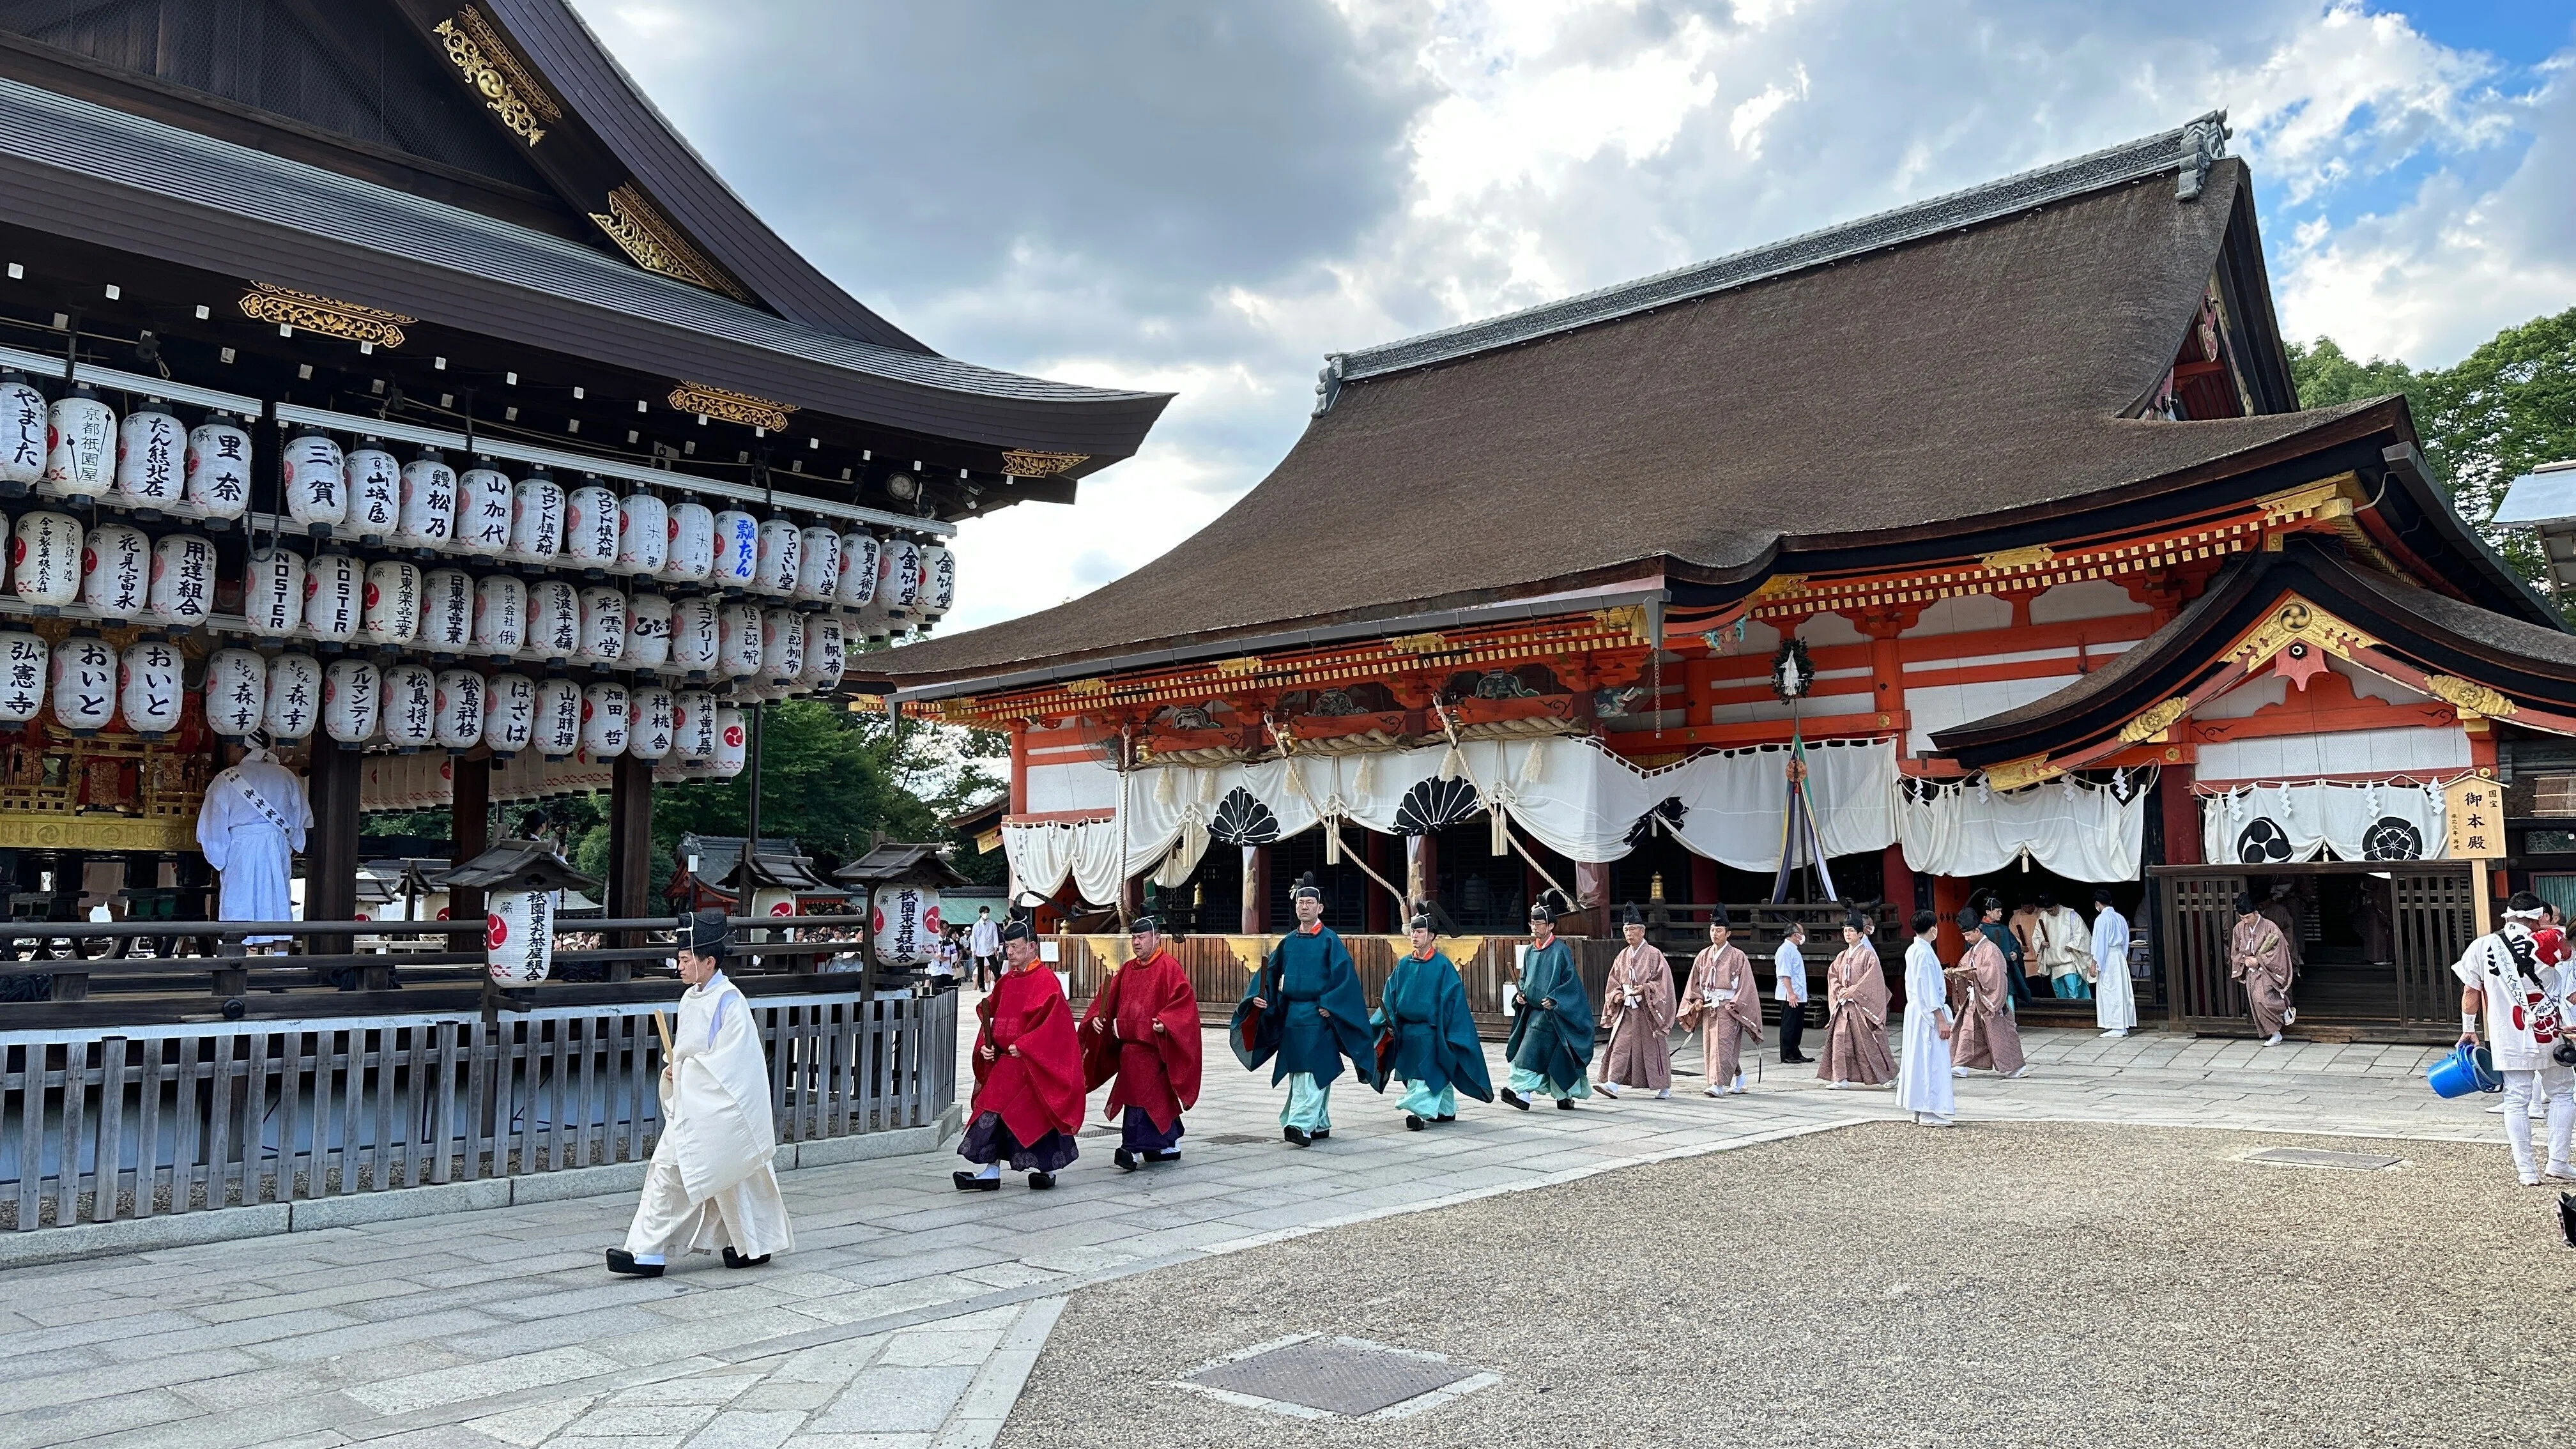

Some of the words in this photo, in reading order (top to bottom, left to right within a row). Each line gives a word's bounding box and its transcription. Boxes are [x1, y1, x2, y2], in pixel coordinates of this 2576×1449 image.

[13, 388, 39, 466] やました
[79, 407, 100, 482] 京都祇園屋
[140, 417, 171, 497] たん熊北店
[211, 435, 241, 501] 里奈
[307, 445, 335, 507] 三賀
[425, 470, 450, 537] 鰻松乃
[480, 475, 506, 544] 山加代
[174, 540, 205, 615] 用達組合
[736, 519, 757, 577] 瓢たん
[777, 528, 797, 591] てっさい堂
[819, 535, 837, 596] てっさい堂
[856, 542, 877, 601] 細見美術館
[898, 547, 919, 606] 金竹堂
[935, 552, 954, 610] 金竹堂
[270, 553, 289, 628] NOSTER
[334, 558, 350, 632] NOSTER
[395, 565, 413, 638] 日東薬品工業
[552, 584, 573, 650] 湯波半老舗
[596, 597, 622, 659] 彩雲堂
[697, 602, 714, 662] エコグリーン
[784, 613, 801, 673] 信三郎帆布
[823, 618, 841, 675] 一澤帆布
[4, 641, 38, 714] 弘憲寺
[79, 643, 107, 715] おいと
[146, 646, 171, 716] おいと
[348, 666, 372, 735] ノルマンディー
[406, 671, 429, 738] 松島将士
[455, 675, 480, 737] 松島祥修
[507, 681, 529, 742] ばざば
[695, 694, 713, 756] 村井歯科医院
[2464, 792, 2487, 849] 御本殿
[2488, 790, 2497, 808] 国宝
[523, 891, 547, 982] 祇園東お茶屋組合
[892, 889, 919, 963] 祇園東芸妓組合
